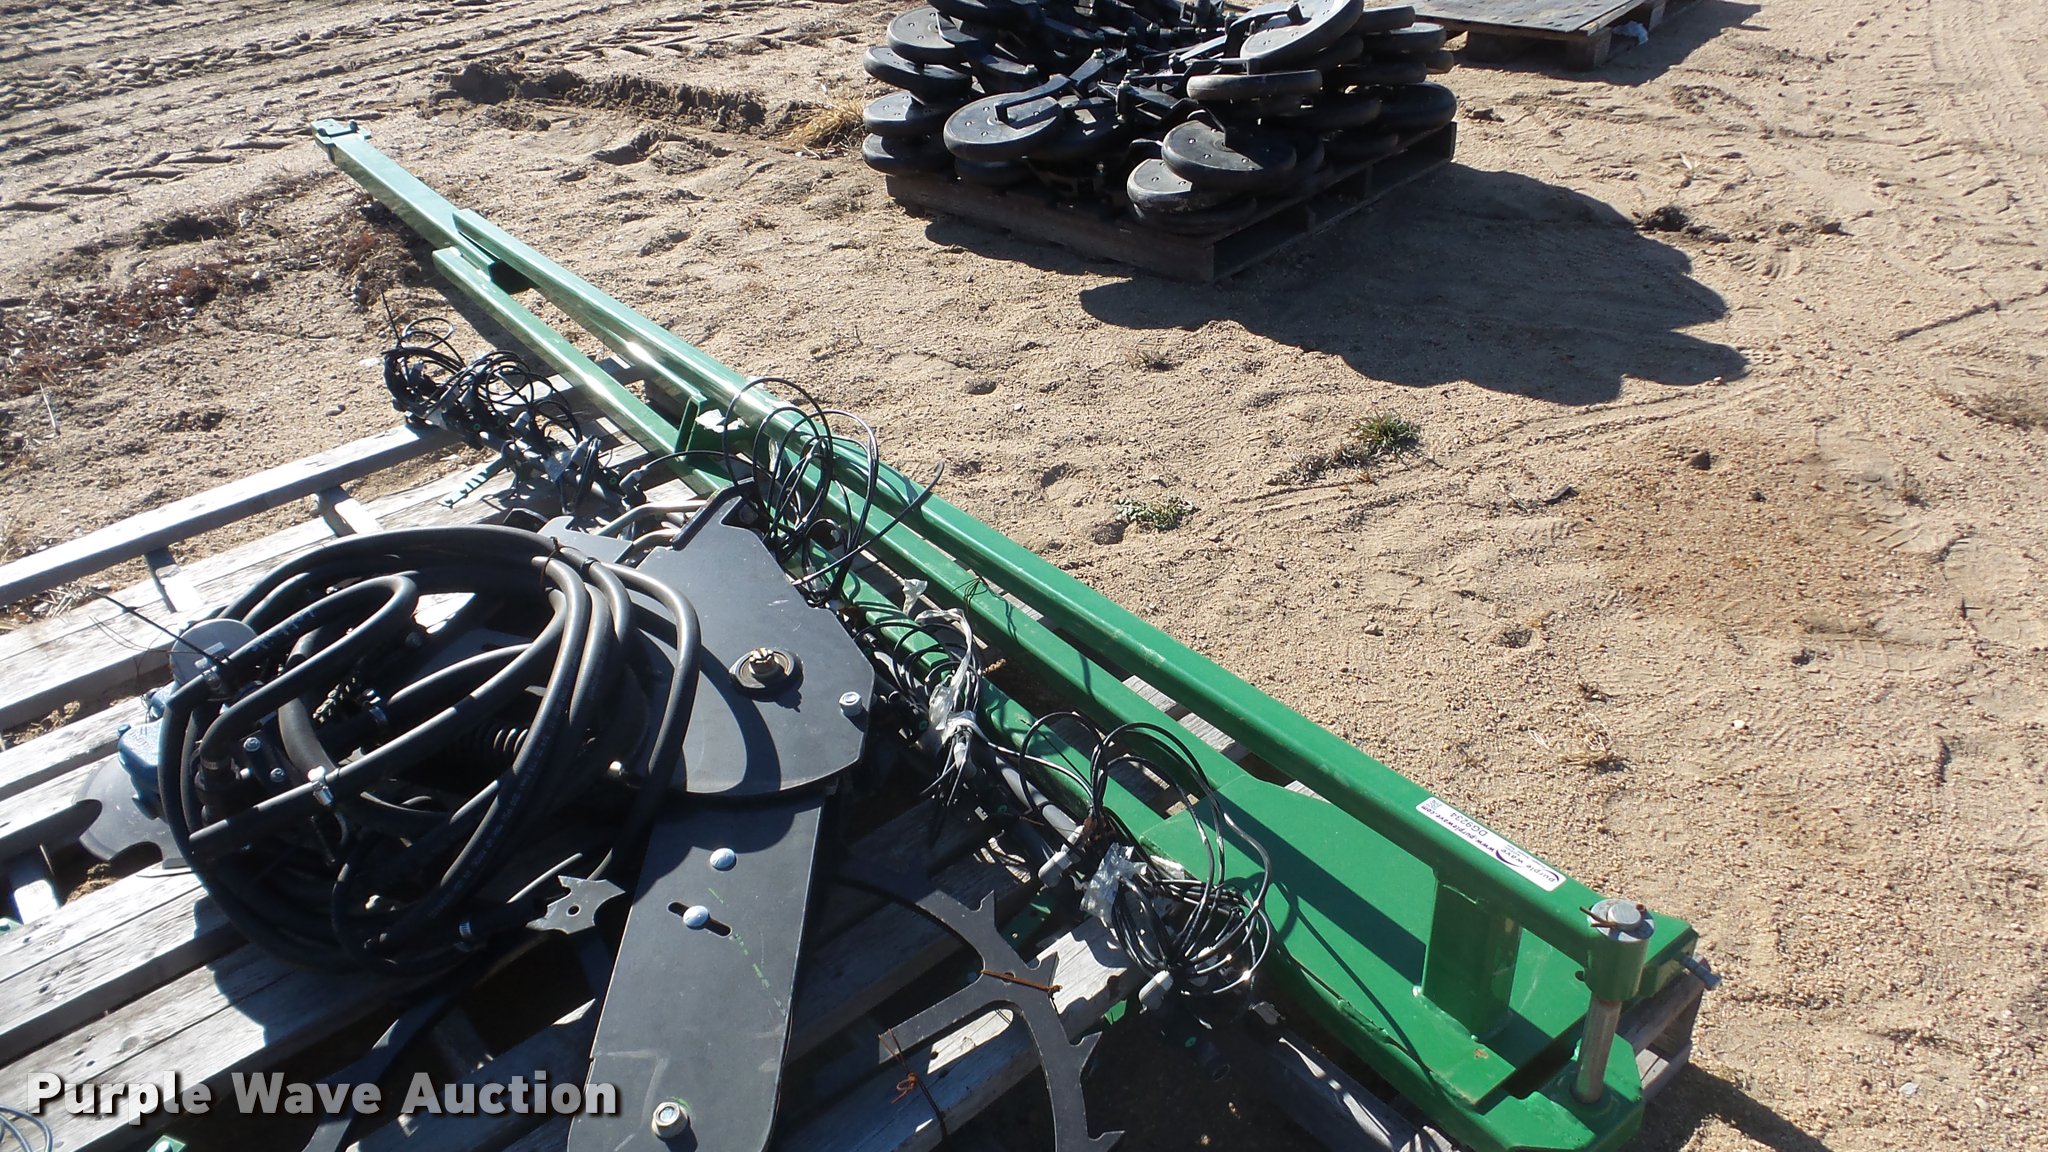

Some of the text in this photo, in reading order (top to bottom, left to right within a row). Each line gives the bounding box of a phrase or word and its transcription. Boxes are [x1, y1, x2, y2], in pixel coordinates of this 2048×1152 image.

[1420, 805, 1495, 853] www.purplewave.com
[1450, 812, 1489, 837] DG9234
[1500, 848, 1524, 864] wave
[1526, 864, 1556, 883] purple
